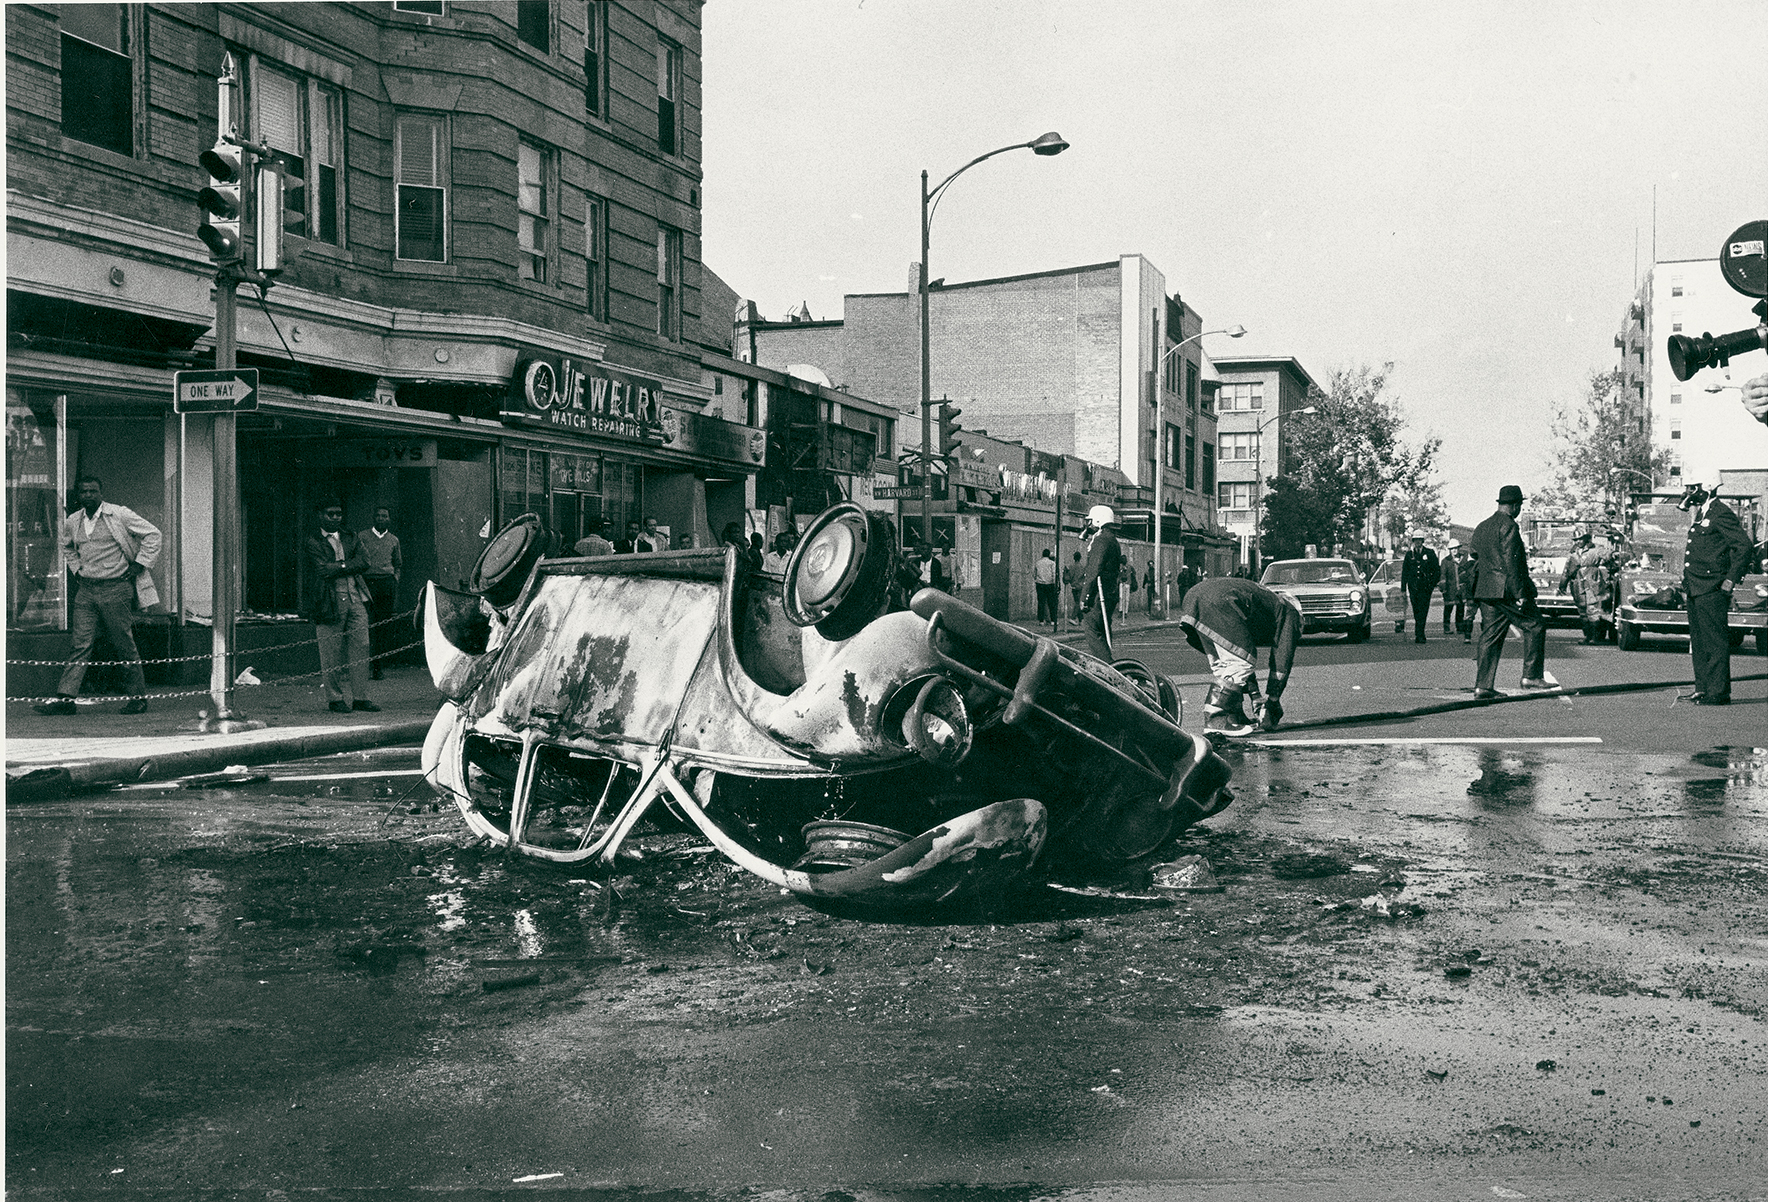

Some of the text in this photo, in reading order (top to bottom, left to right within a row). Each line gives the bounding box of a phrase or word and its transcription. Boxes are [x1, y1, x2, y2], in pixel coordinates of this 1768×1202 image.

[190, 384, 234, 398] ONE WAY
[555, 359, 663, 422] JEWELRY
[551, 410, 641, 437] WATCH REPAIRING
[882, 487, 911, 498] HARVARD
